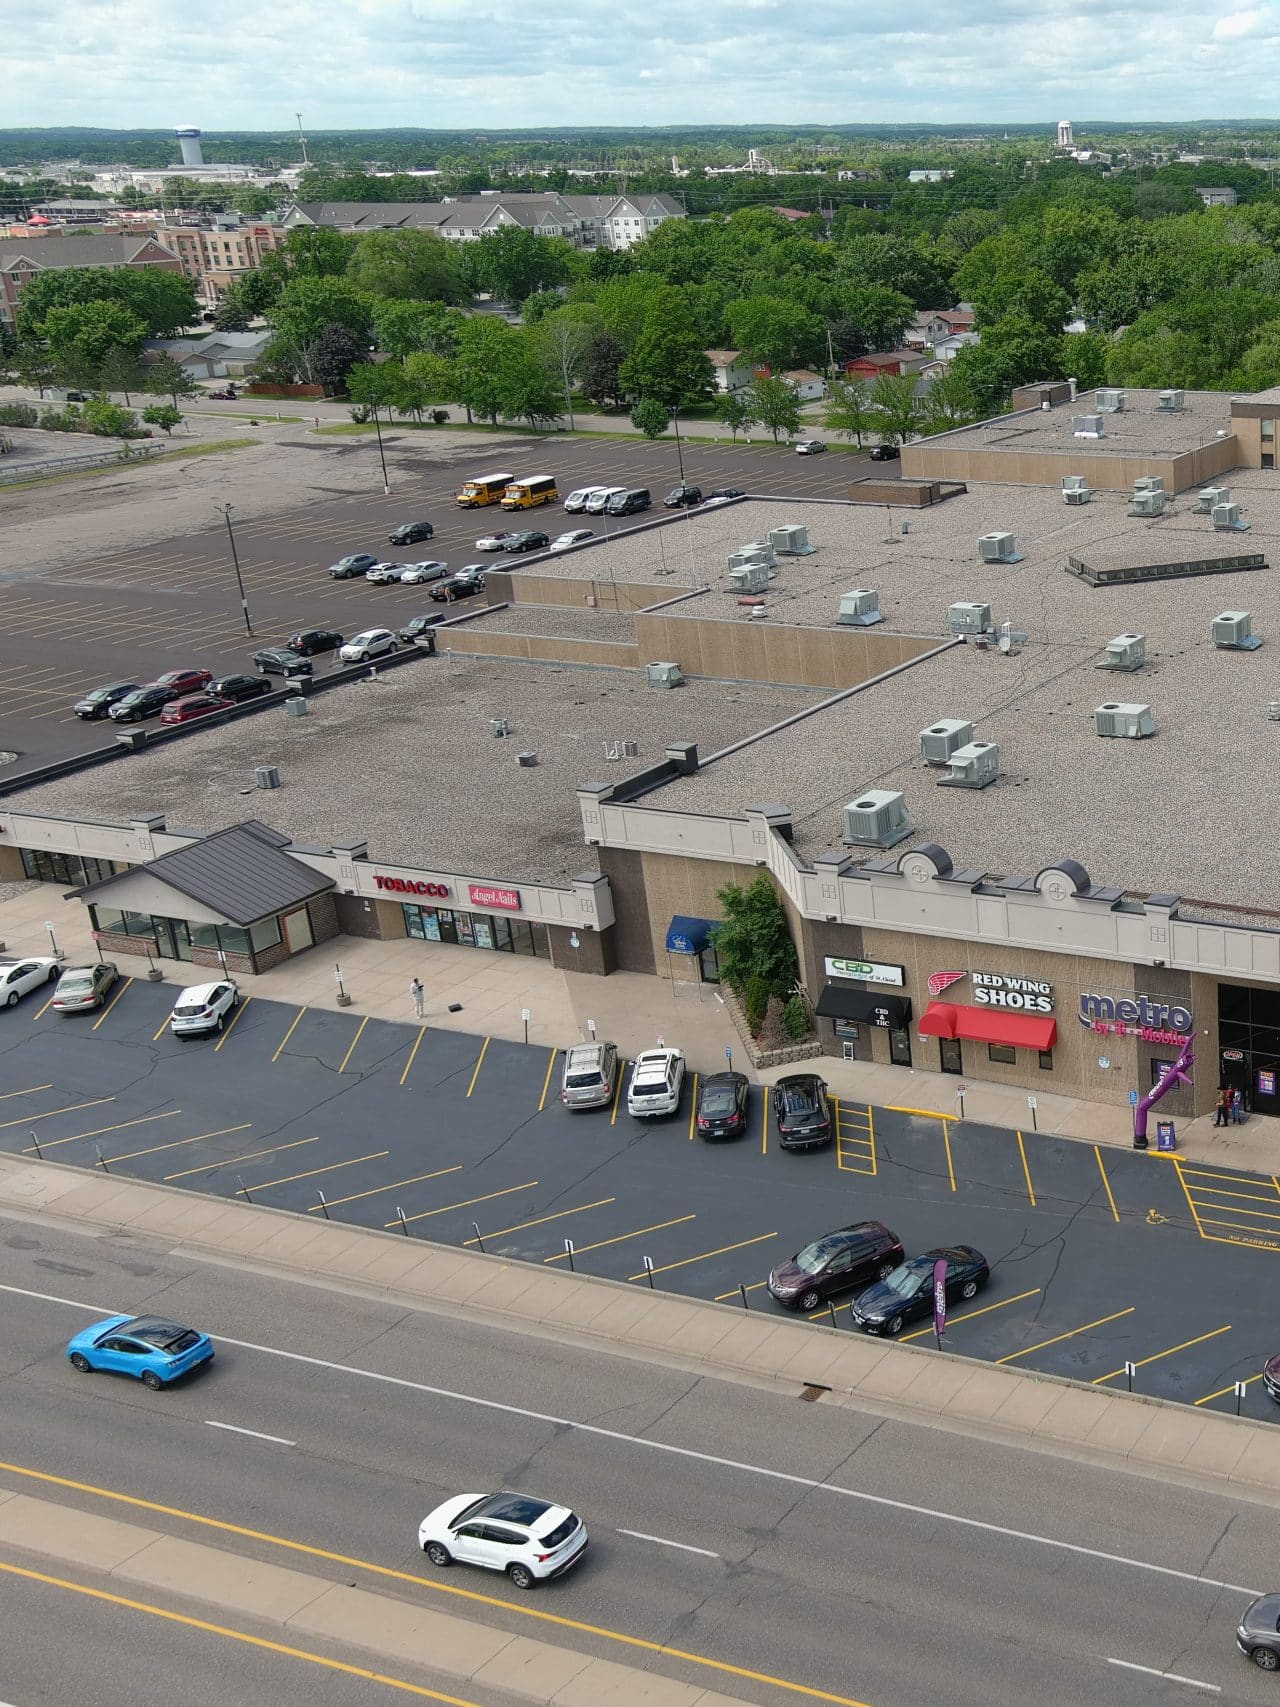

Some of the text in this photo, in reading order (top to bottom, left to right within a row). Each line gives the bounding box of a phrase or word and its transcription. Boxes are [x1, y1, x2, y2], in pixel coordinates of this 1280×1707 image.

[373, 875, 449, 898] TOBACCO
[471, 888, 518, 905] Angel Nails
[831, 959, 874, 974] CBD
[972, 972, 1051, 994] RED WING
[974, 987, 1052, 1012] SHOES
[875, 1019, 890, 1027] THC
[1079, 993, 1192, 1032] metro
[1093, 1019, 1109, 1039] by
[1242, 1237, 1279, 1247] PARKING
[934, 1281, 946, 1315] metro
